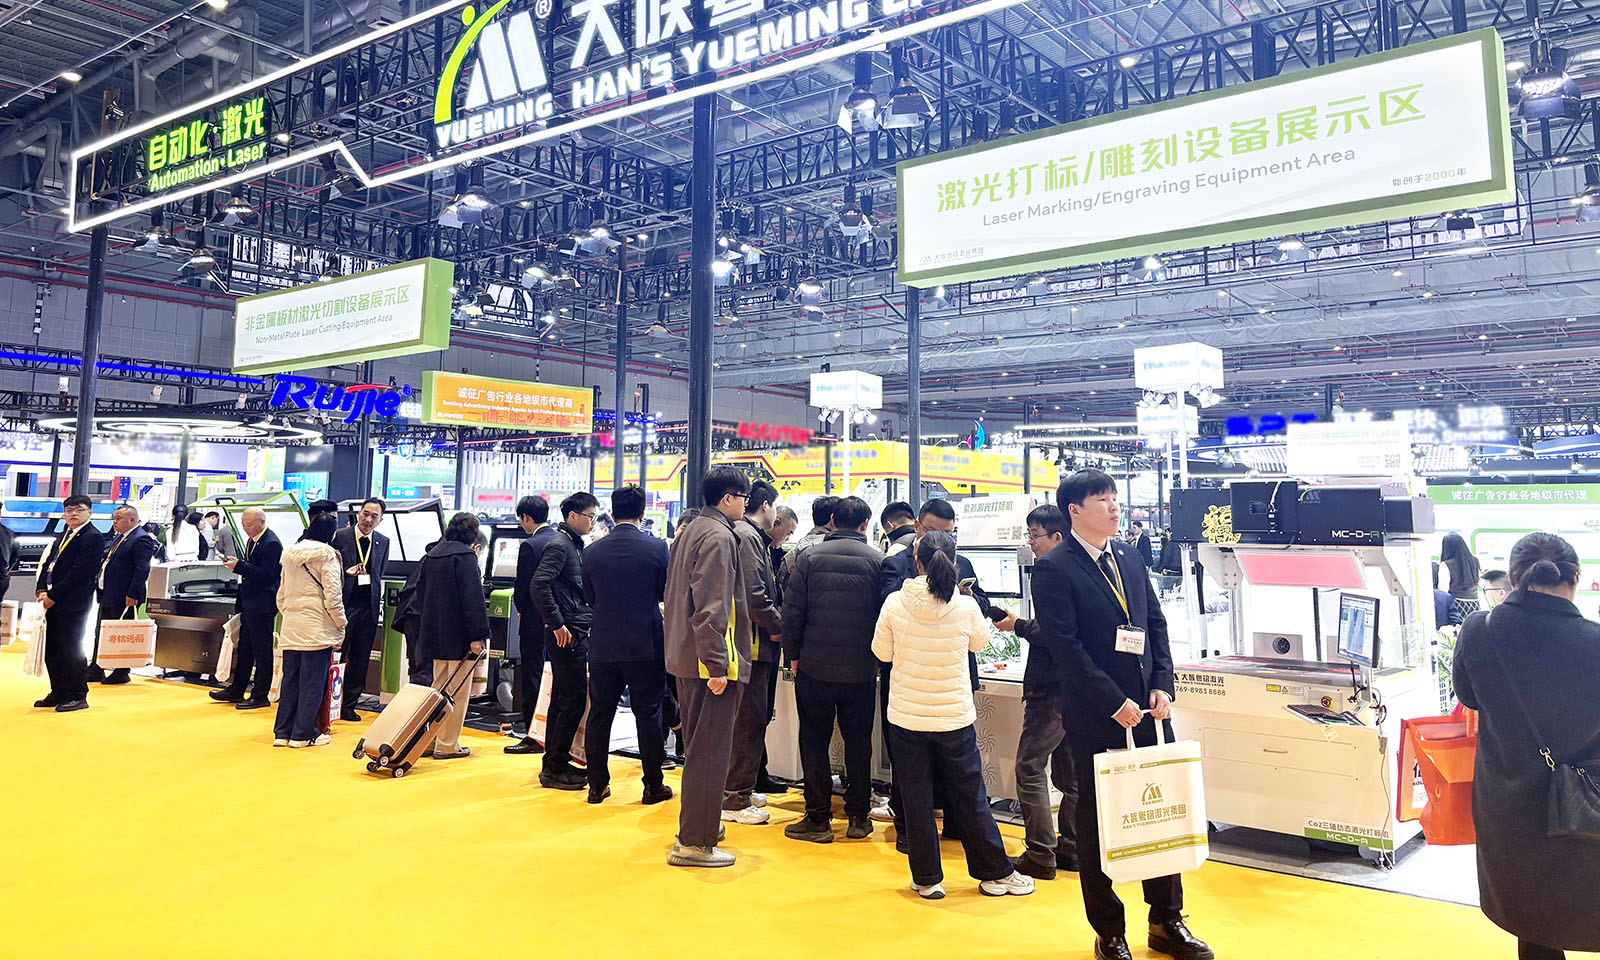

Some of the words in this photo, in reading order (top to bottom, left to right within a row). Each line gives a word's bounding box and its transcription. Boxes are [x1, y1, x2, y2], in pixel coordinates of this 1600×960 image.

[680, 0, 869, 75] YUEMING
[435, 92, 553, 148] YUEMING
[937, 83, 1426, 213] 激光打标/雕刻设备展示区
[983, 208, 1024, 226] Laser
[1027, 178, 1190, 219] Marking/Engraving
[1195, 156, 1302, 188] Equipment
[1306, 149, 1356, 168] Area
[245, 284, 411, 332] 非金属板材激光切割设备展示区
[255, 332, 285, 344] Non-Metal
[285, 331, 300, 339] Plate
[301, 327, 318, 337] Laser
[318, 322, 342, 337] Cutting
[342, 316, 377, 331] Equipment
[377, 314, 393, 323] Area
[457, 386, 574, 409] 诚征广告行业各地级市代理商
[1174, 685, 1208, 696] 769-8983
